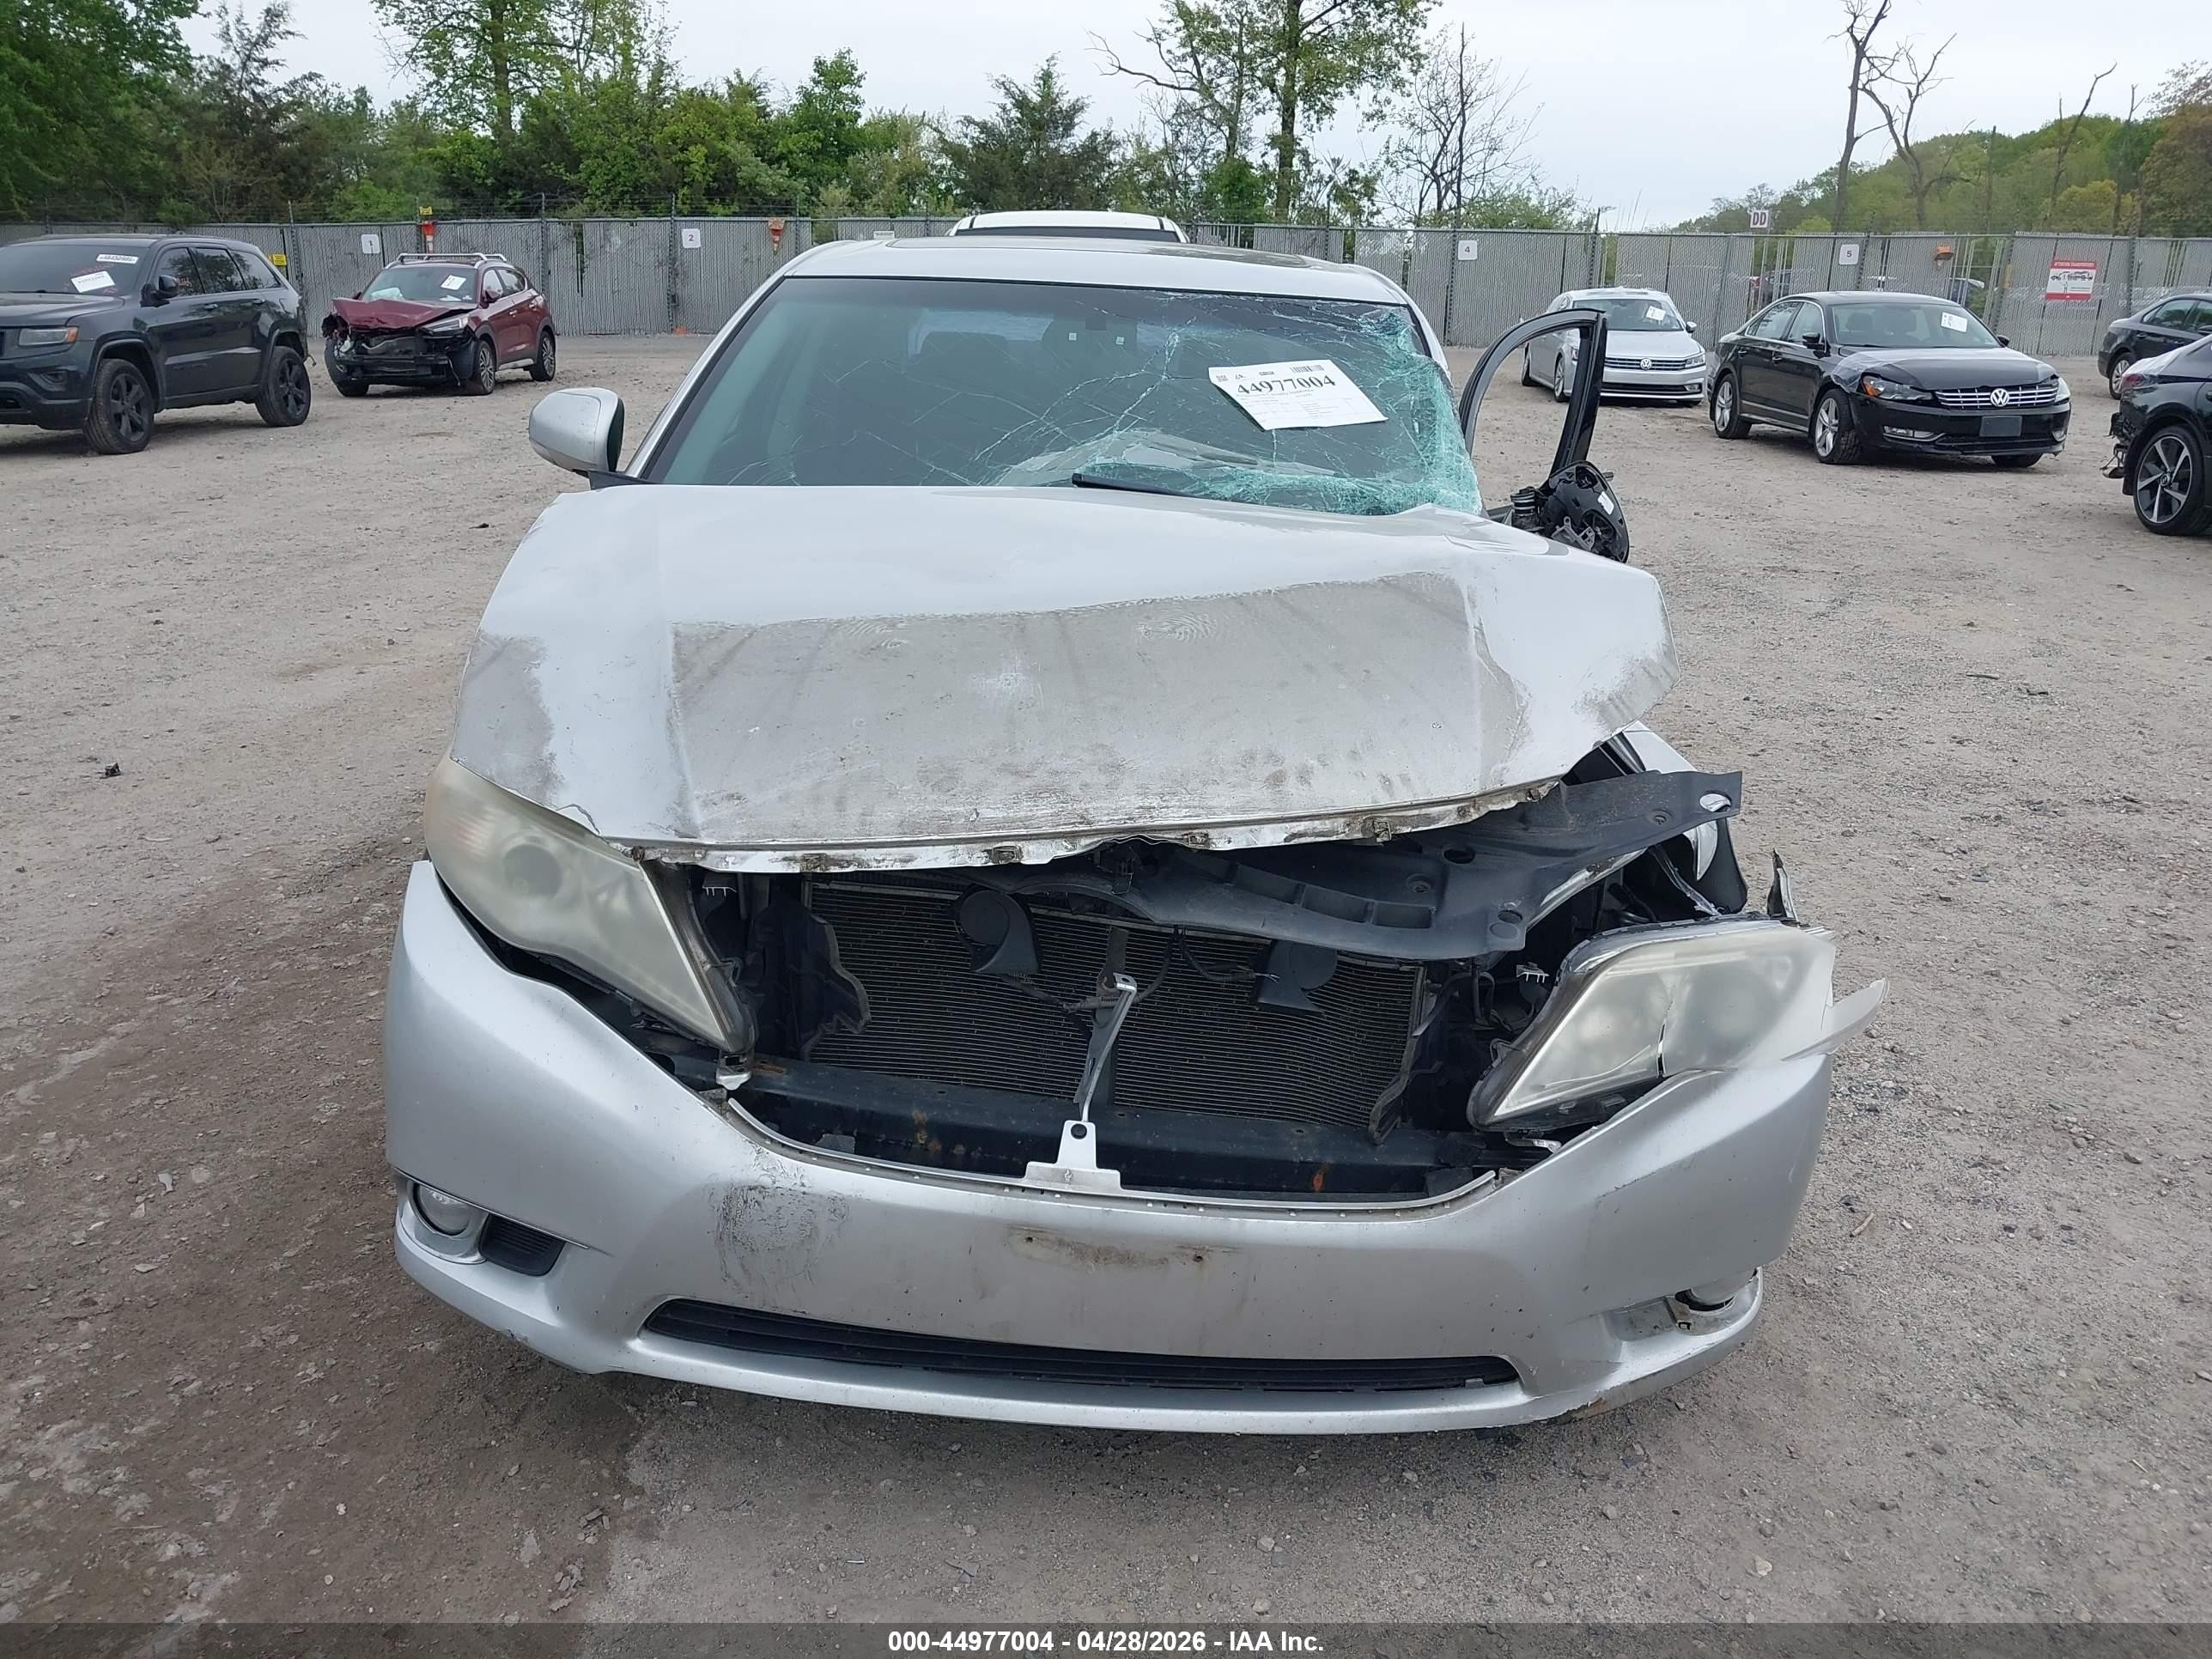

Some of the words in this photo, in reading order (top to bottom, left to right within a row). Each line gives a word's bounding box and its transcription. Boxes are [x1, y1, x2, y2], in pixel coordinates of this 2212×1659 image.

[1752, 211, 1767, 226] DD
[1237, 374, 1336, 394] 44977004
[1990, 388, 2009, 408] VW
